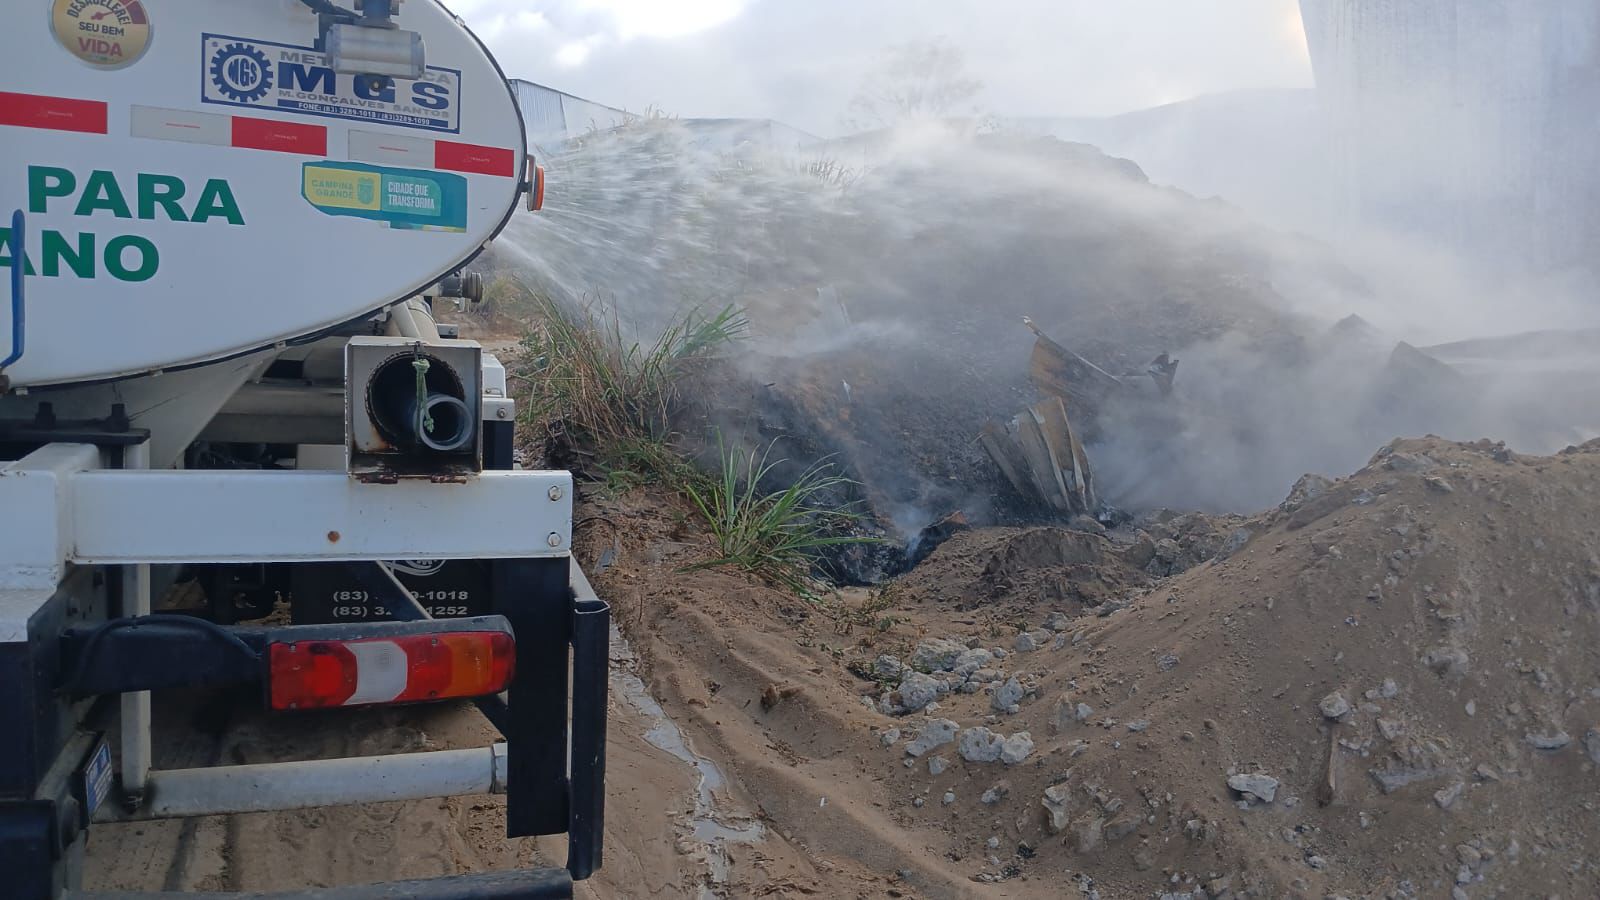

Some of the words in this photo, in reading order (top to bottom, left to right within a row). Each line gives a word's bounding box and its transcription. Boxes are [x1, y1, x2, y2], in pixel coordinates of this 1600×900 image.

[79, 21, 100, 32] SEU
[102, 25, 125, 36] BEM
[78, 37, 122, 57] VIDA
[228, 58, 258, 87] MGS
[394, 104, 449, 118] SANTOS
[312, 179, 354, 190] CAMPINA
[388, 181, 413, 194] CIDADE
[414, 184, 429, 196] QUE
[28, 165, 246, 225] PARA
[316, 187, 354, 199] GRANDE
[388, 194, 435, 209] TRANSFORMA
[332, 590, 369, 602] (83)
[332, 606, 368, 618] (83)
